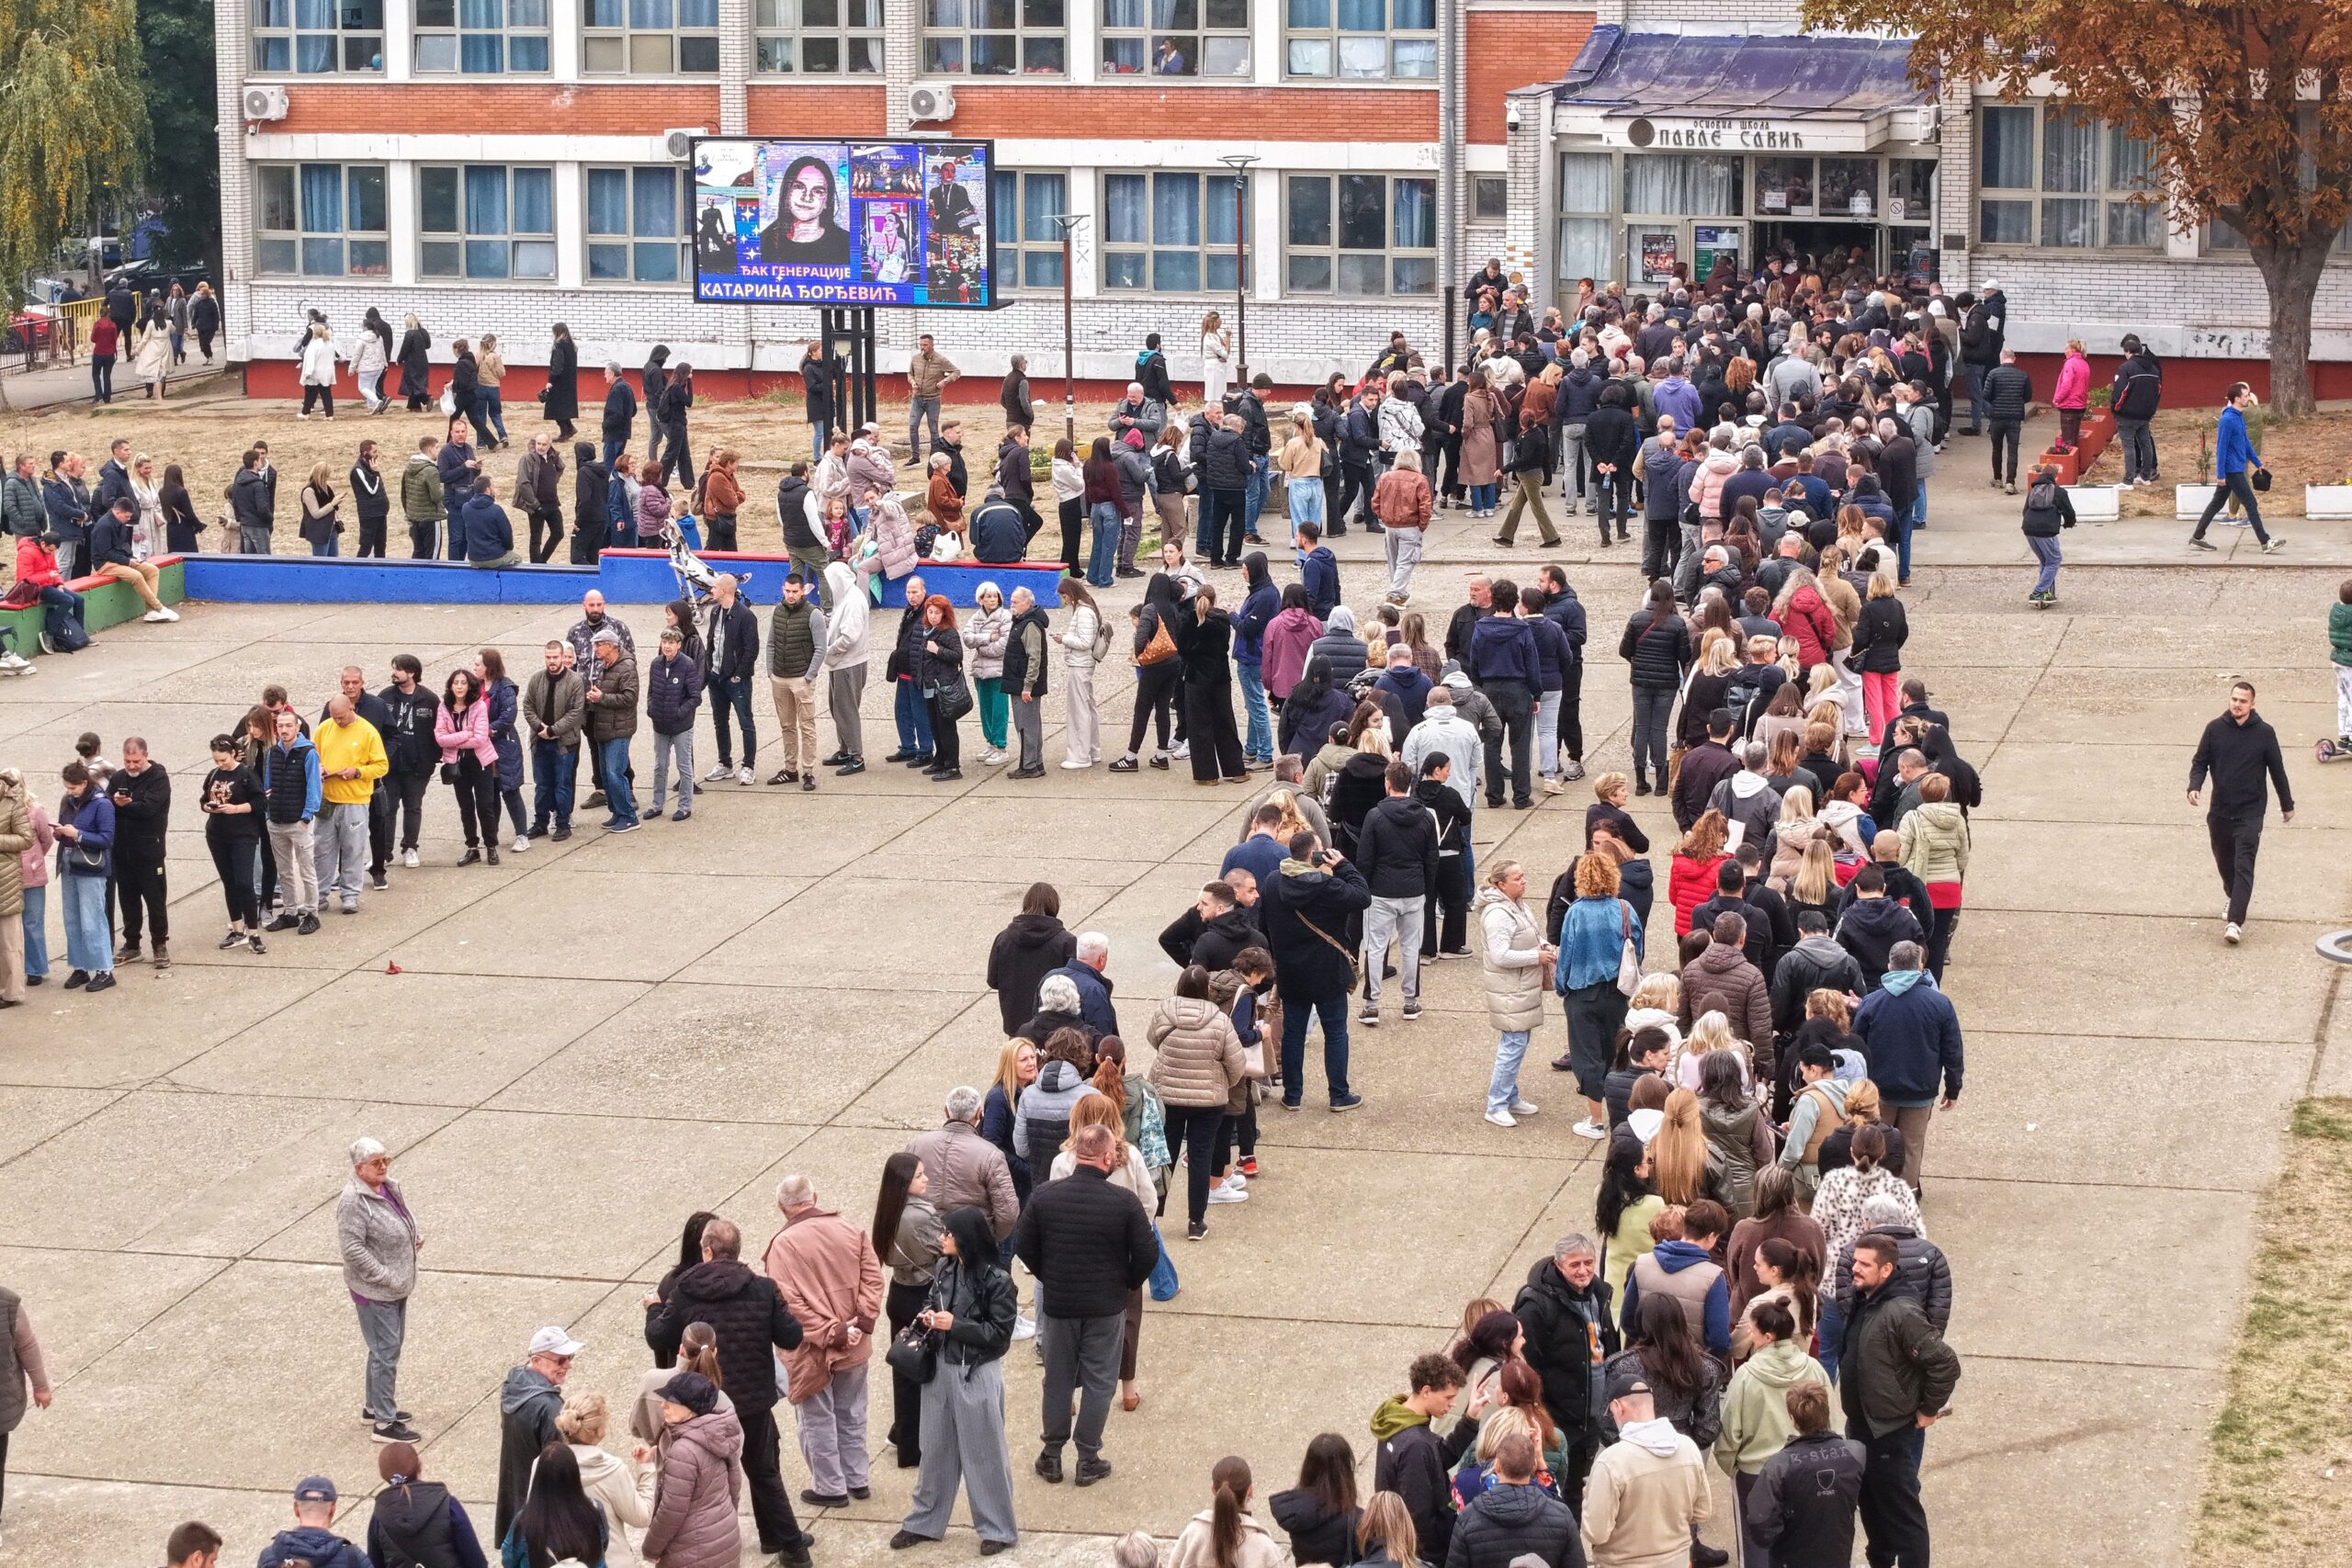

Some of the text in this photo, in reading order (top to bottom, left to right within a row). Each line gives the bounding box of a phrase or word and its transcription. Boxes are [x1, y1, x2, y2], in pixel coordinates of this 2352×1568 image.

[1739, 120, 1770, 130] ШКОЛА
[1659, 129, 1804, 149] ПАВЛЕ САВИЋ
[740, 265, 851, 280] ЂАК ГЕНЕРАЦИЈЕ
[700, 282, 897, 301] КАТАРИНА ЂОРЂЕВИЋ
